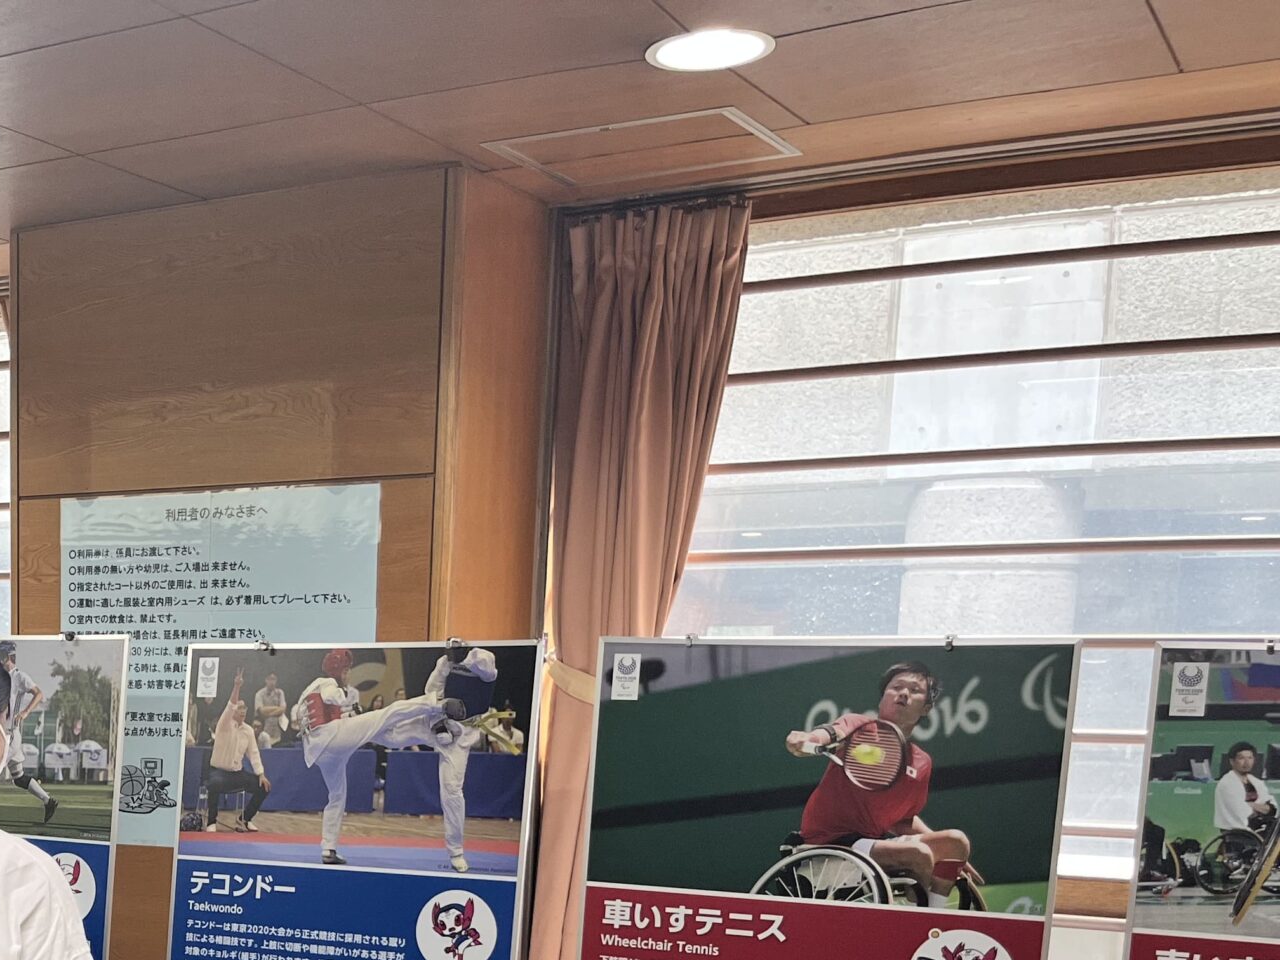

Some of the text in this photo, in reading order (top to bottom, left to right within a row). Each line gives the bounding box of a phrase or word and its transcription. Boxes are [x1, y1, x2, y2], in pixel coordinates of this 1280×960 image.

[165, 504, 268, 521] 利用者のみなさまへ
[124, 711, 183, 722] 更衣室でお願
[189, 870, 296, 899] テコンドー
[188, 900, 243, 915] Taekwondo
[601, 898, 787, 943] 車いすテニス
[600, 934, 720, 956] Wheelchair Tennis
